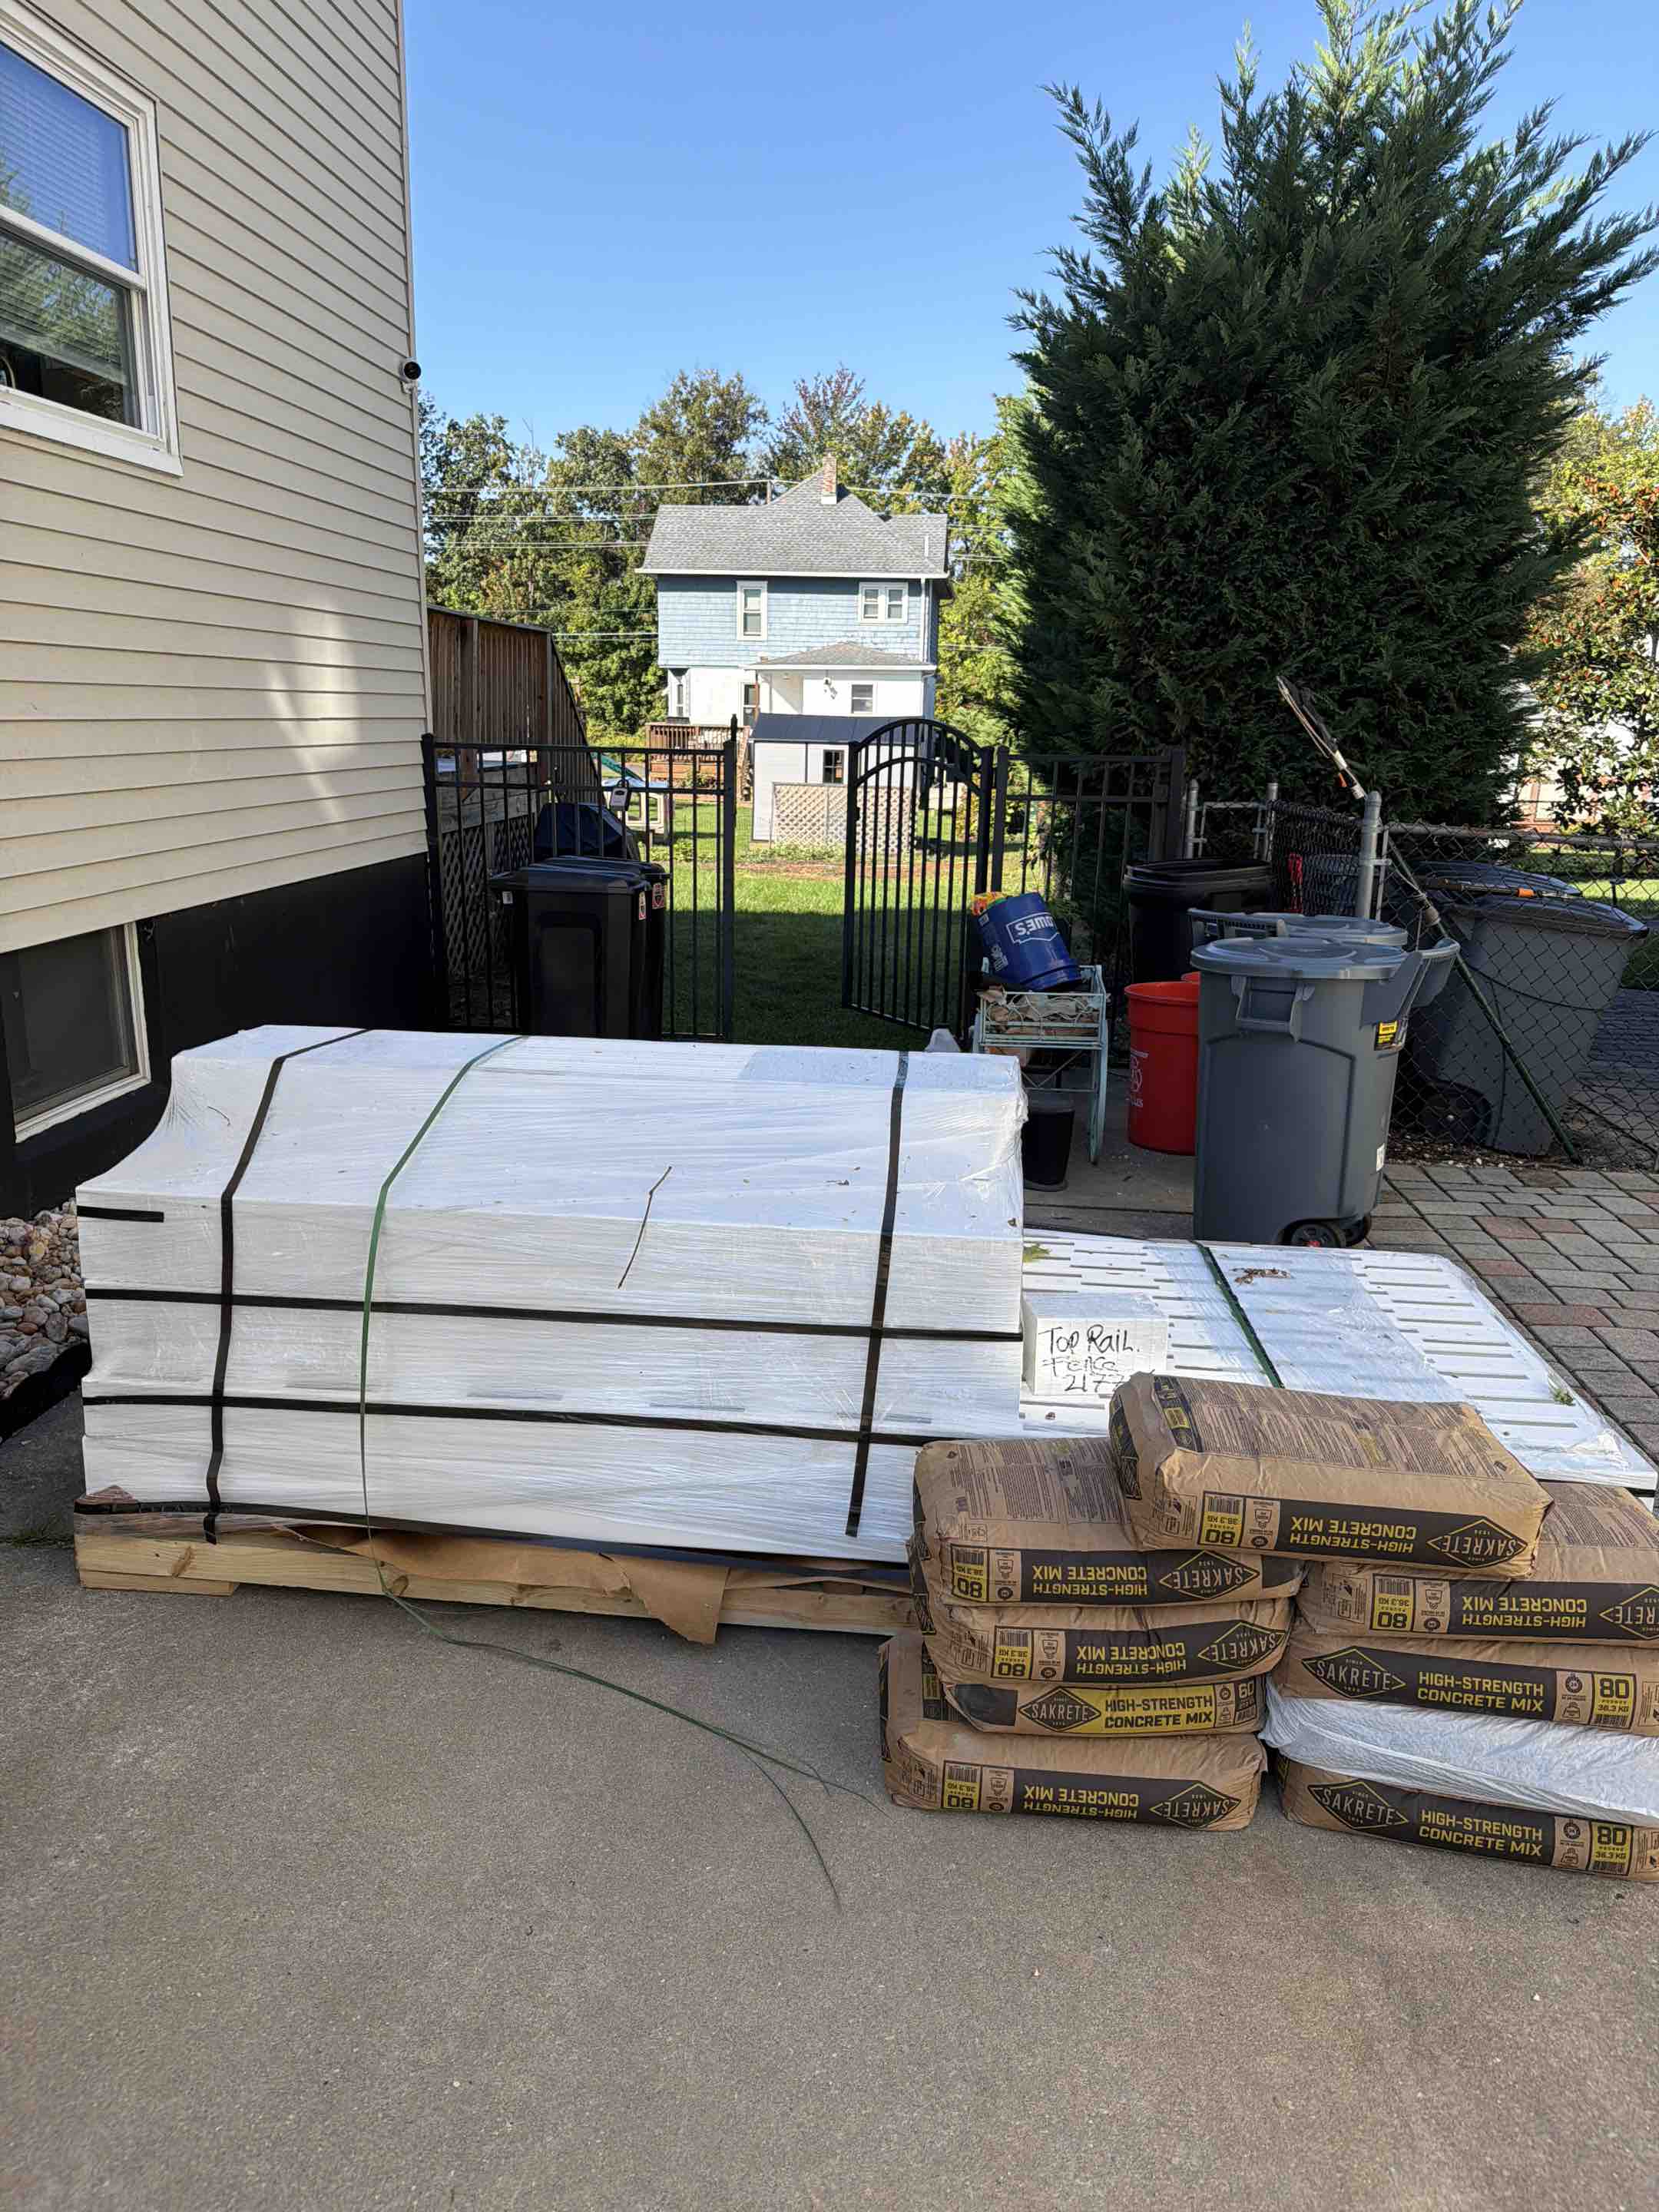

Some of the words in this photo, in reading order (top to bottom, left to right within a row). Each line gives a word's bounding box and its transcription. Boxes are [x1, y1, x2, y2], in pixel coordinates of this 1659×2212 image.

[1291, 1515, 1323, 1532] MIX
[1329, 1519, 1417, 1539] CONCRETE
[1205, 1529, 1235, 1545] 80
[1290, 1532, 1415, 1553] HIGH-STRENGTH
[1441, 1535, 1517, 1556] SAKRETE
[1033, 1565, 1063, 1581] MIX
[1068, 1566, 1147, 1581] CONCRETE
[1173, 1566, 1243, 1589] SAKRETE
[957, 1578, 982, 1598] 80
[1032, 1583, 1148, 1597] HIGH-STRENGTH
[1462, 1596, 1494, 1611] MIX
[1498, 1597, 1587, 1612] CONCRETE
[1378, 1611, 1408, 1629] 80
[1462, 1614, 1586, 1628] HIGH-STRENGTH
[1614, 1605, 1659, 1624] RETE
[1076, 1646, 1106, 1661] MIX
[1111, 1642, 1186, 1660] CONCRETE
[1211, 1633, 1277, 1661] SAKRETE
[998, 1662, 1025, 1677] 80
[1076, 1660, 1186, 1675] HIGH-STRENGTH
[1316, 1660, 1392, 1690] SAKRETE
[1419, 1671, 1544, 1697] HIGH-STRENGTH
[1600, 1677, 1629, 1699] 80
[1105, 1695, 1213, 1713] HIGH-STRENGTH
[1417, 1687, 1505, 1709] CONCRETE
[1511, 1698, 1544, 1713] MIX
[1031, 1704, 1088, 1721] SAKRETE
[1104, 1714, 1181, 1729] CONCRETE
[1185, 1711, 1213, 1724] MIX
[1024, 1784, 1053, 1801] MIX
[1058, 1788, 1139, 1808] CONCRETE
[948, 1795, 972, 1809] 80
[1024, 1802, 1137, 1820] HIGH-STRENGTH
[1163, 1798, 1229, 1818] SAKRETE
[1323, 1787, 1395, 1825] SAKRETE
[1421, 1810, 1543, 1842] HIGH-STRENGTH
[1419, 1826, 1505, 1851] CONCRETE
[1510, 1839, 1542, 1856] MIX
[1598, 1826, 1627, 1846] 80
